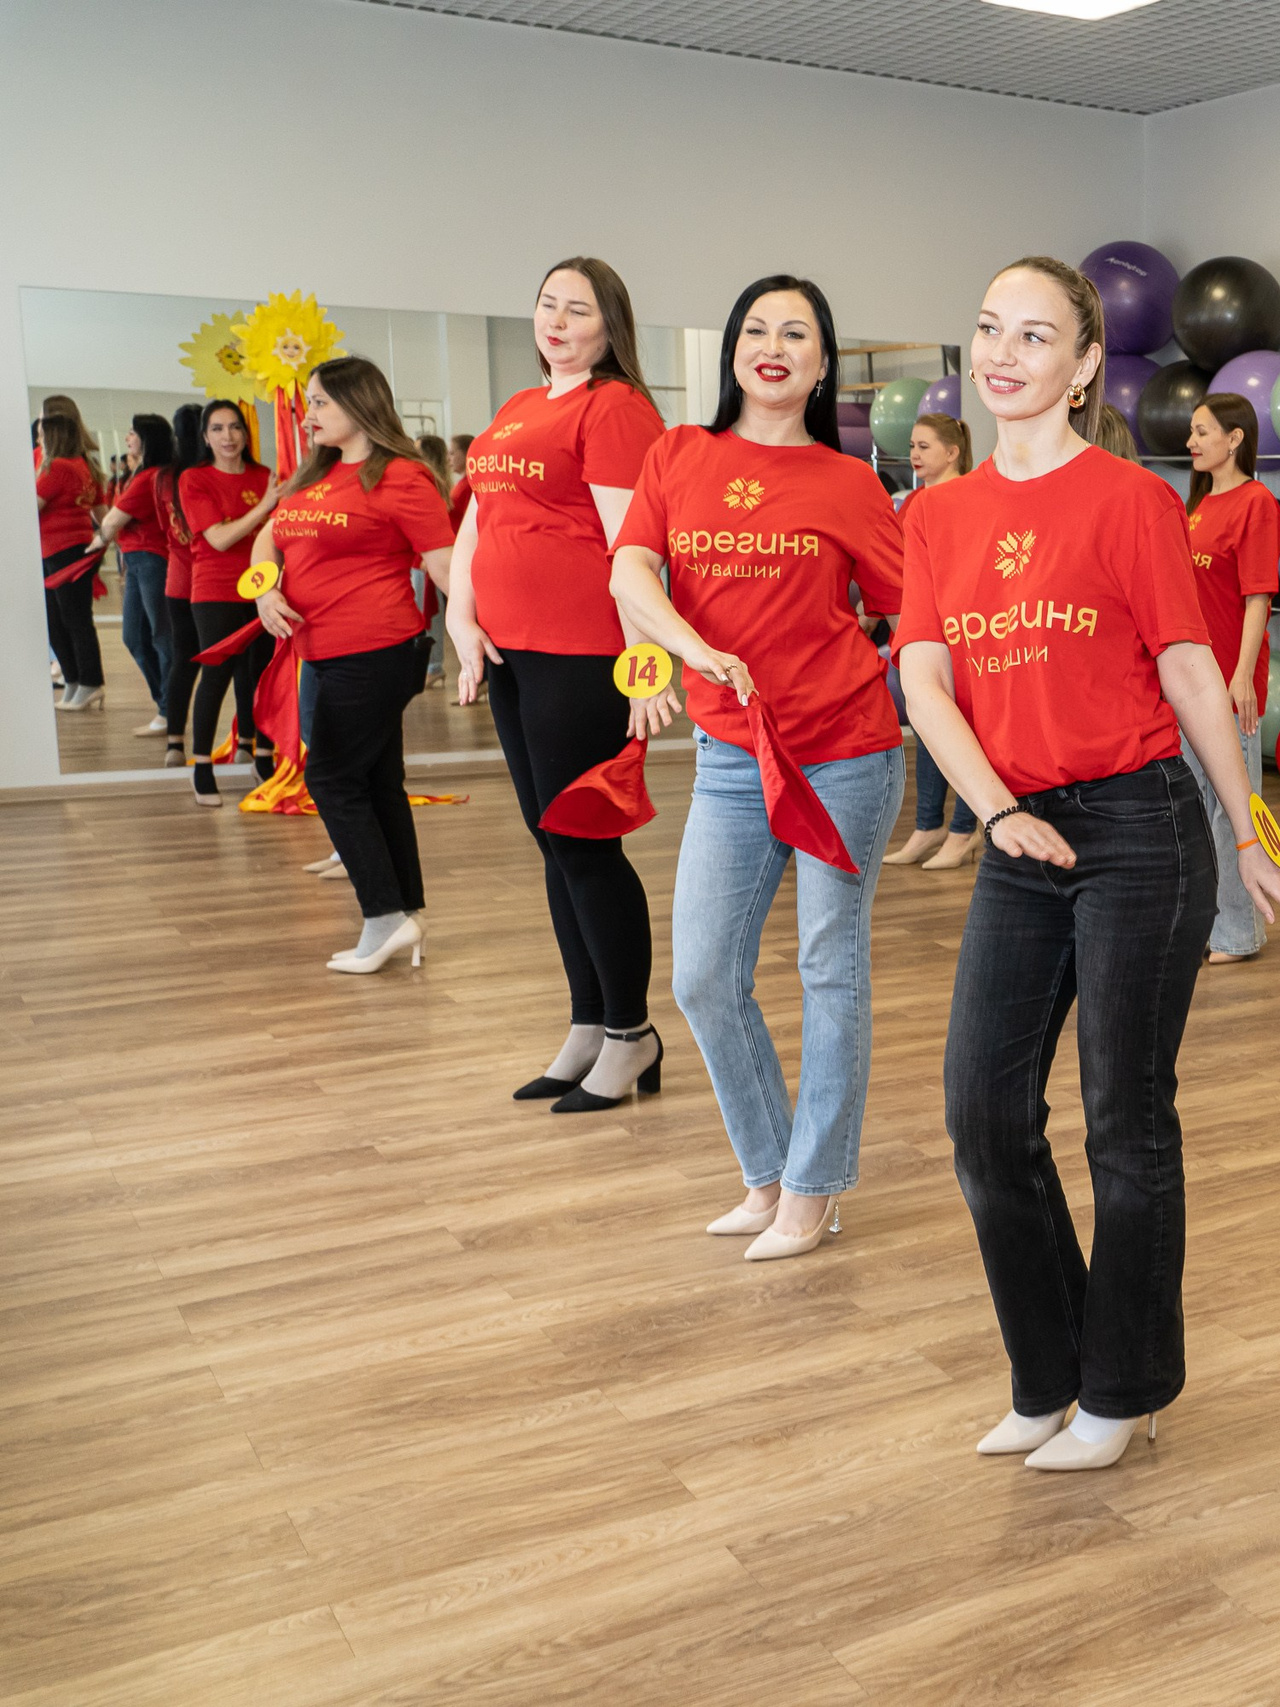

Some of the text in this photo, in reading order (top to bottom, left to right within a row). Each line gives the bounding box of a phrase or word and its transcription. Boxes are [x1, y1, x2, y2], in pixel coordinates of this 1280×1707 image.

[467, 454, 545, 481] региня
[276, 508, 348, 528] региня
[668, 527, 819, 558] берегиня
[685, 562, 782, 579] чувашии
[943, 600, 1099, 649] ерегиня
[627, 655, 659, 687] 14
